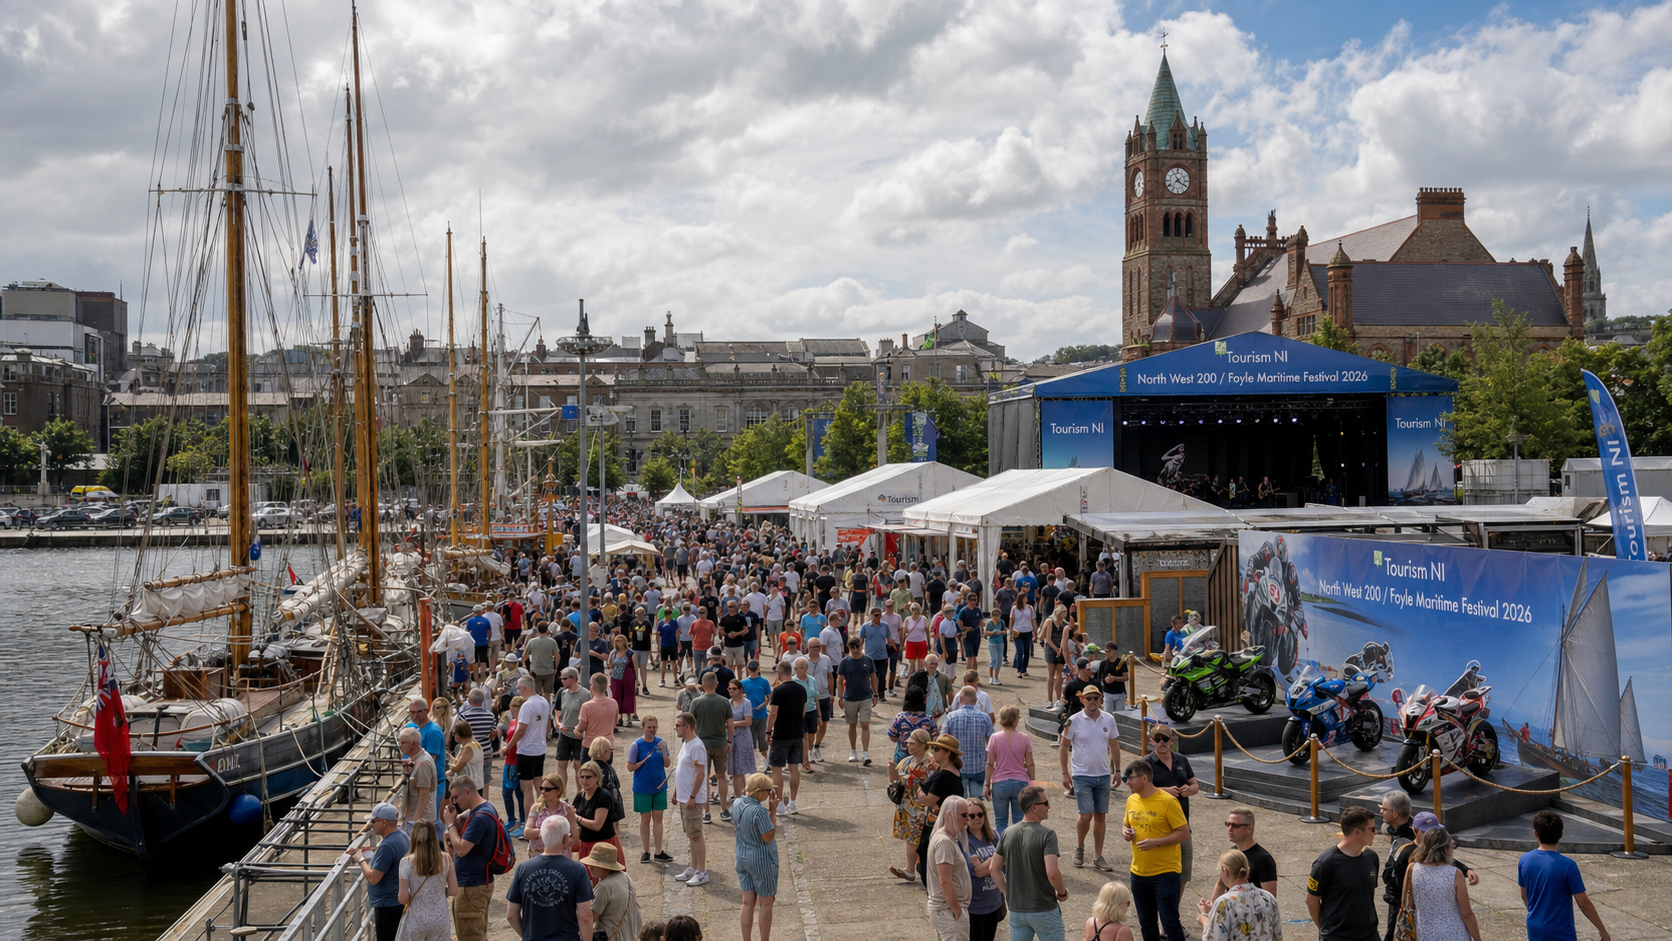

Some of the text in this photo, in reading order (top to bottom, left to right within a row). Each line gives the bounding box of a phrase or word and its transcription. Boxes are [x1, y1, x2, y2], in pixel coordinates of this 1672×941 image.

[1226, 350, 1288, 363] Tourism NI
[1137, 370, 1368, 386] North West 200 / Foyle Maritime Festival 2026
[1050, 422, 1104, 434] Tourism NI
[1395, 417, 1446, 428] Tourism NI
[1607, 440, 1623, 466] NI
[887, 495, 920, 503] Tourism
[1384, 557, 1445, 582] Tourism NI
[1319, 579, 1532, 623] North West 200 / Foyle Maritime Festival 2026
